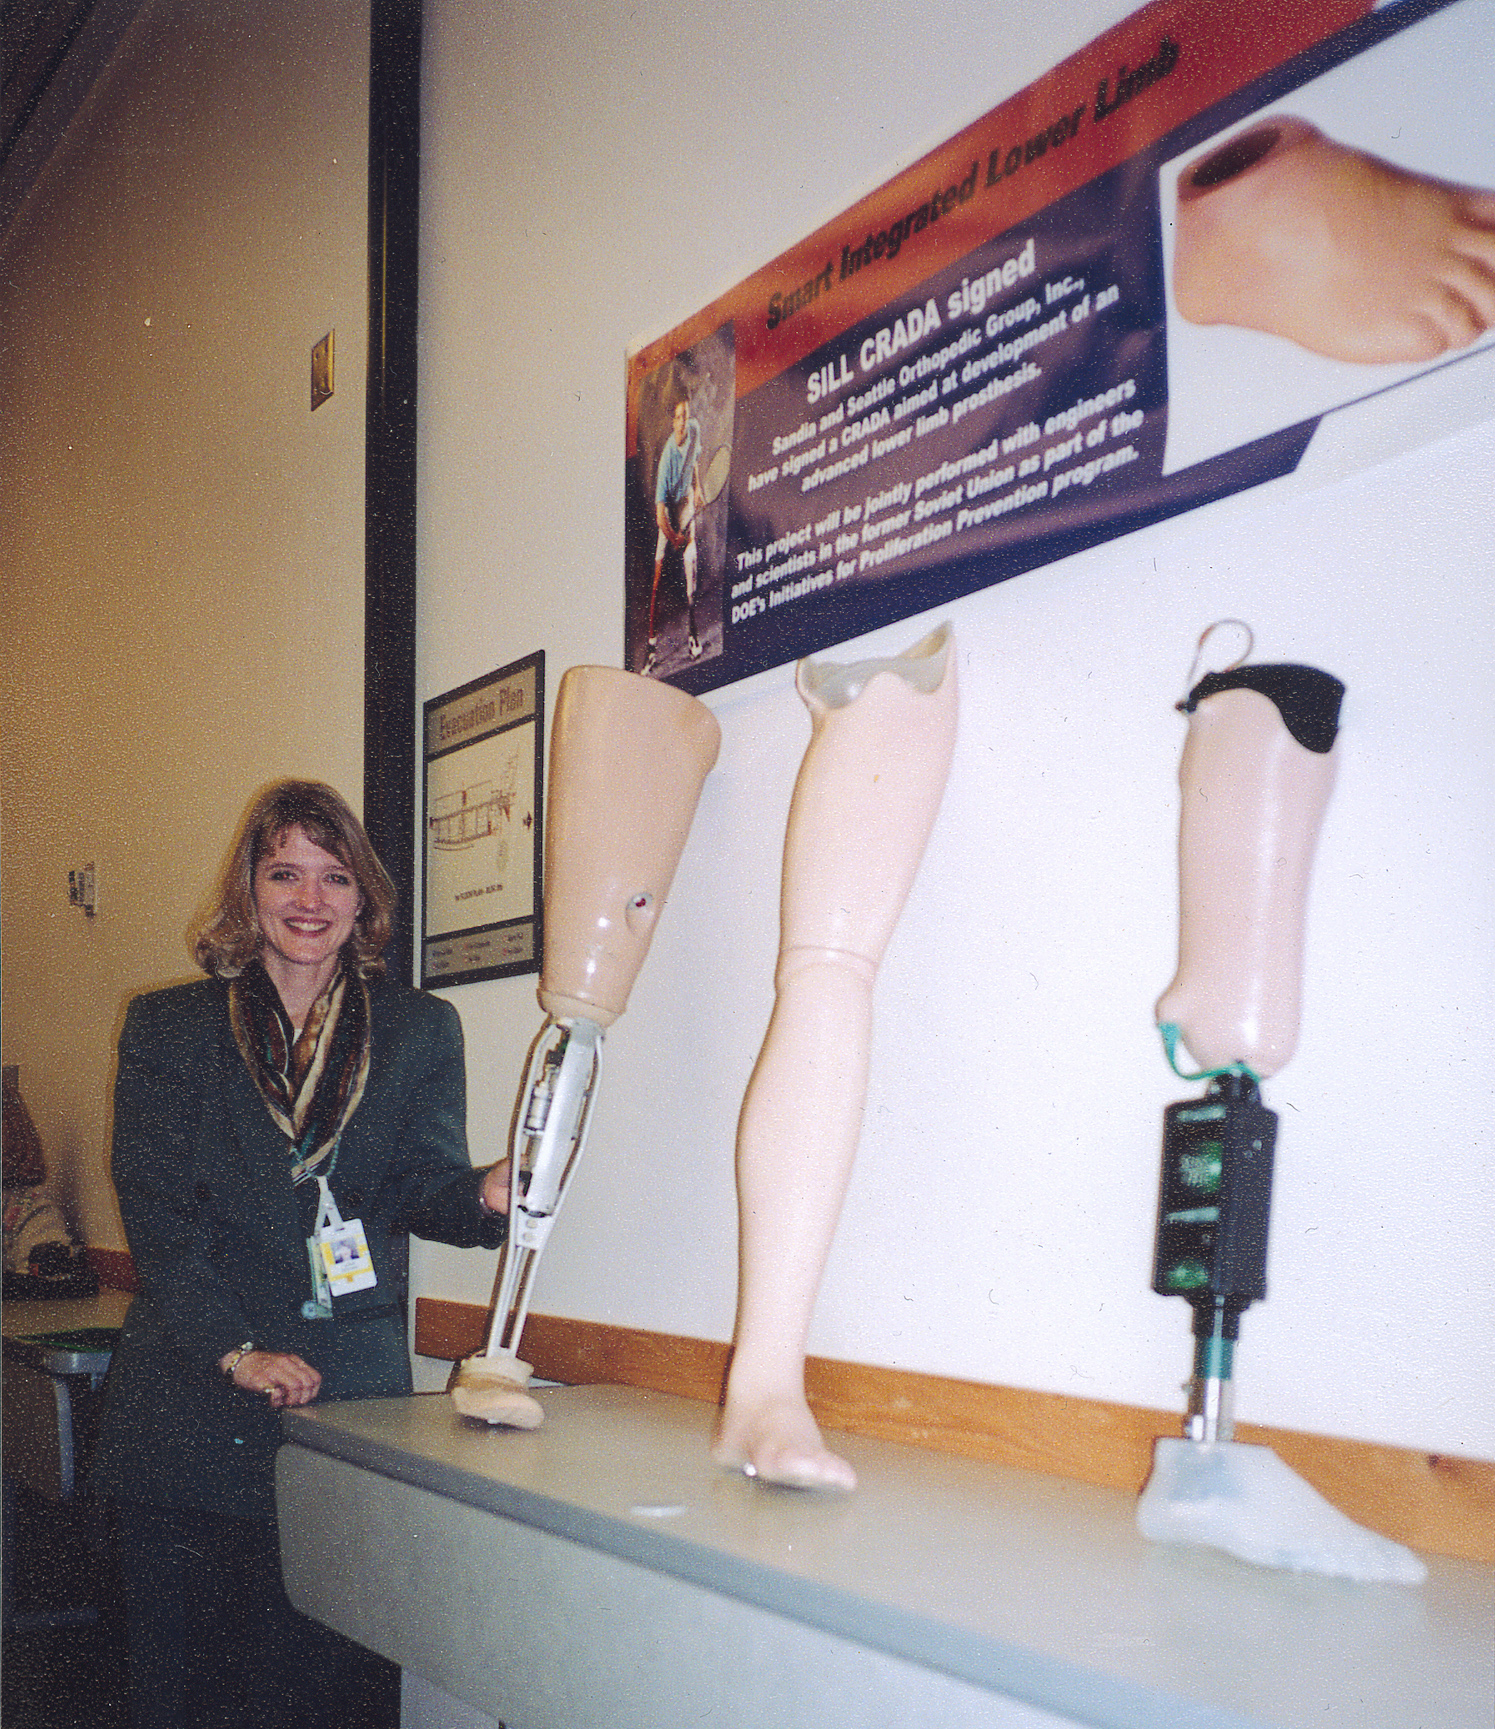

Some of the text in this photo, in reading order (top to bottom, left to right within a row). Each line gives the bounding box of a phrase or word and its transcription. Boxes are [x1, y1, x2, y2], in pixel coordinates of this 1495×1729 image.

[766, 35, 1180, 330] Smart Integrated Lower Limb
[748, 284, 1120, 492] have signed a CRADA aimed at development of an
[773, 420, 816, 456] Sandia
[820, 404, 844, 431] and
[848, 377, 895, 416] Seattle
[899, 329, 981, 385] Orthopedic
[986, 299, 1041, 338] Group,
[807, 239, 1036, 403] SILL CRADA signed
[731, 409, 1144, 599] and scientists in the former Soviet Union as part of the
[737, 379, 1136, 571] This project will be jointly performed with engineers
[801, 361, 1041, 492] advanced lower limb prosthesis.
[732, 445, 1139, 624] DOE's Initiatives for Proliferation Prevention program.
[440, 686, 524, 740] Evacuation Plan
